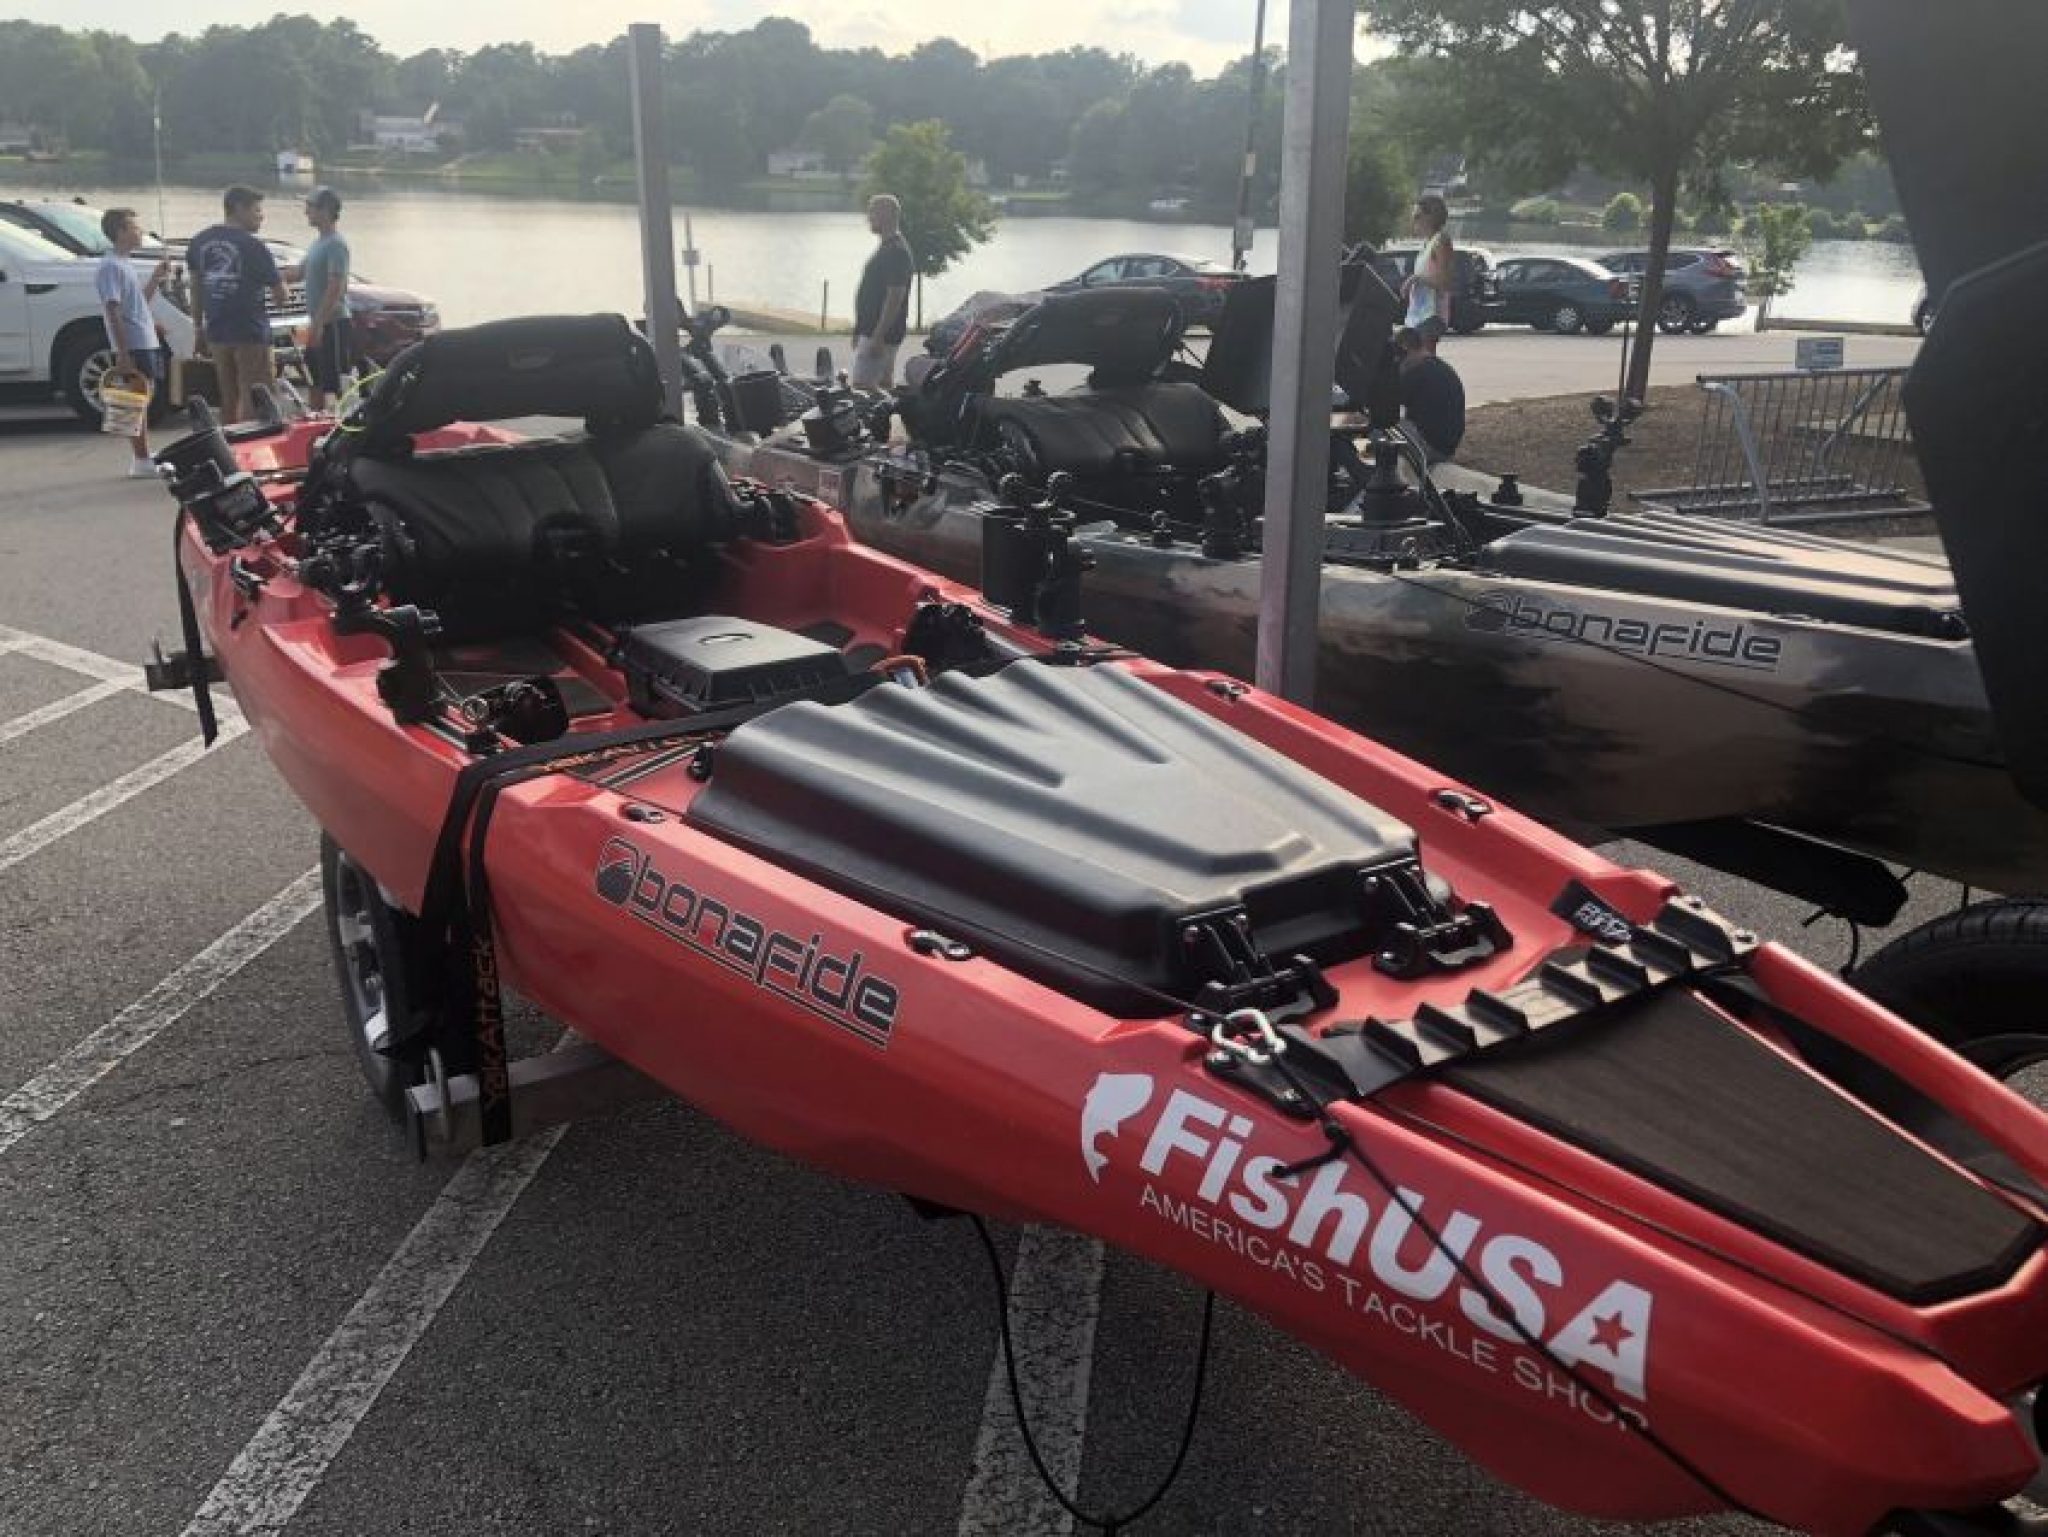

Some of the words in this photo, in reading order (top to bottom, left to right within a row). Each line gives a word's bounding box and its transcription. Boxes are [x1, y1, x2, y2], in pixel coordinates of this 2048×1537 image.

[1507, 597, 1782, 663] bonafide
[631, 853, 899, 1035] bonafide
[1139, 1087, 1653, 1402] FishUSA
[1140, 1183, 1325, 1291] AMERICA'S
[1336, 1273, 1499, 1373] TACKLE
